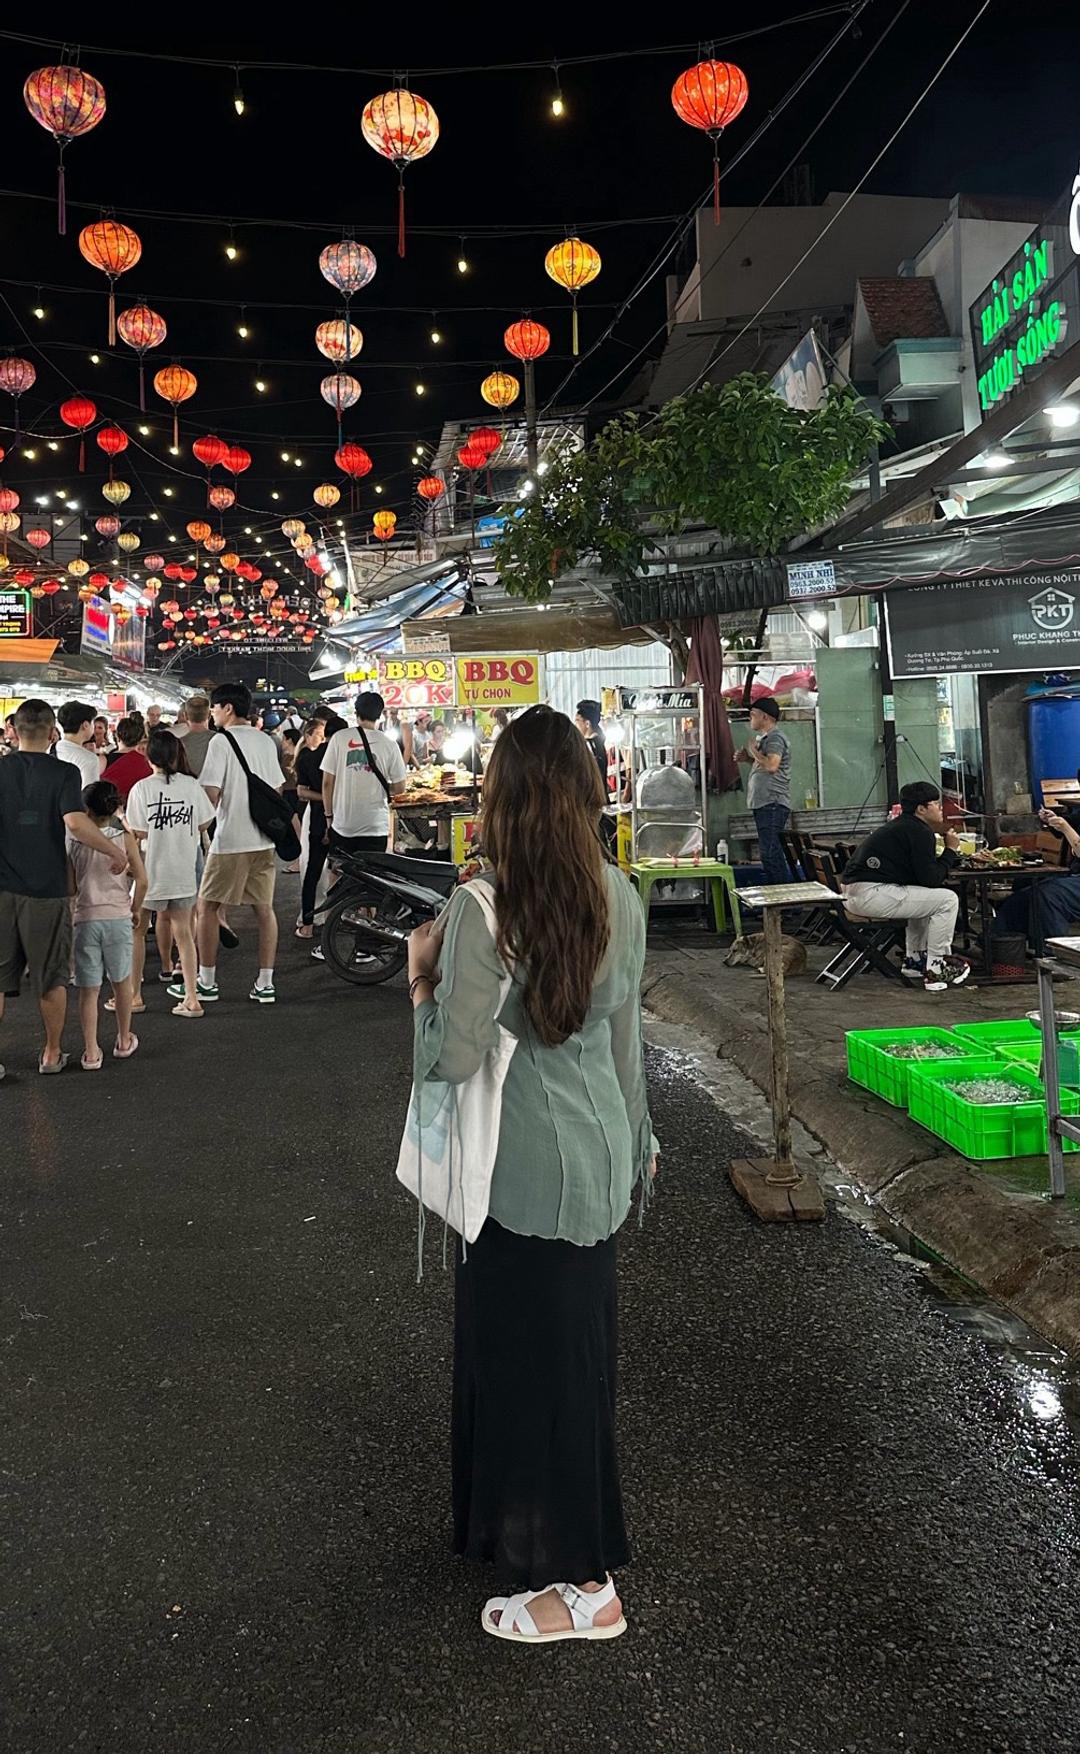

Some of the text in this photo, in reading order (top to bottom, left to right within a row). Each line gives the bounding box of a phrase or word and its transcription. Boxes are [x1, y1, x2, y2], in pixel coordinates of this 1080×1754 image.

[981, 240, 1048, 346] HẢI SẢN
[788, 570, 814, 580] MINH
[1005, 577, 1022, 586] THI
[1023, 575, 1052, 585] CÔNG
[385, 660, 448, 682] BBQ
[464, 660, 535, 685] BBQ
